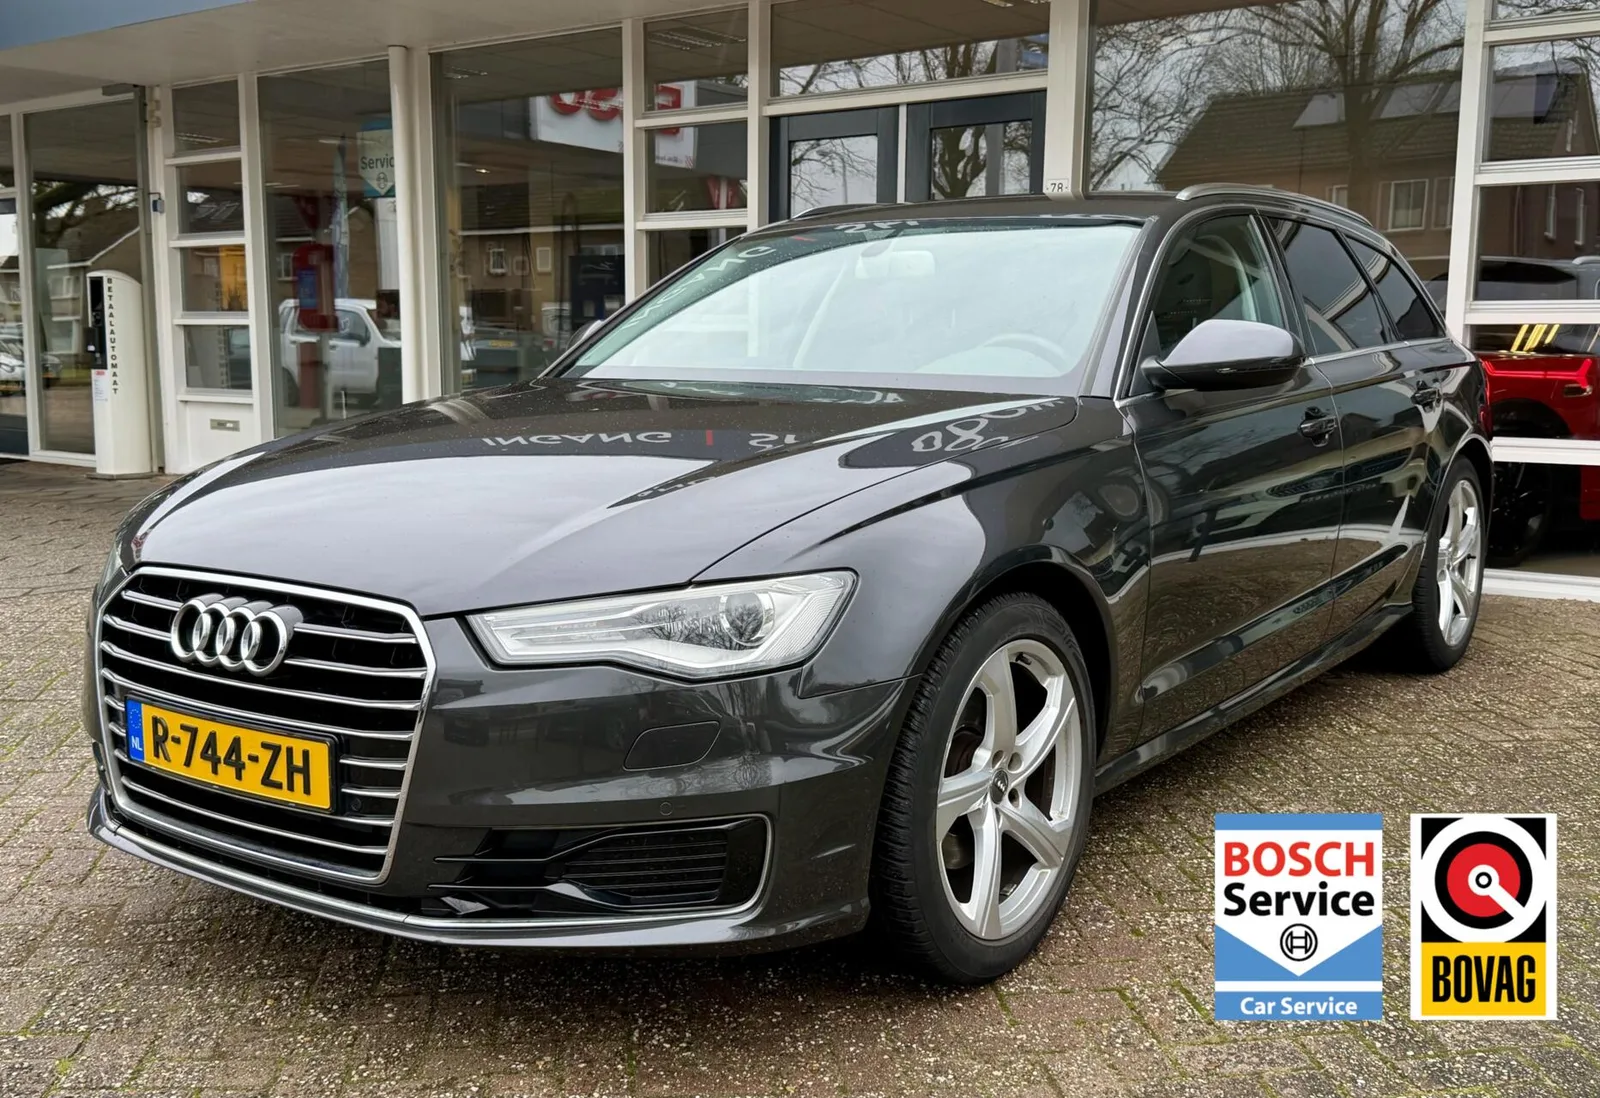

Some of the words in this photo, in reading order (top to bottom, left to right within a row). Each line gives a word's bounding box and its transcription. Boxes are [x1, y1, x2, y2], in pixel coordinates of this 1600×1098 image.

[361, 153, 395, 170] Servic
[1050, 182, 1064, 193] 78
[107, 277, 119, 395] BETAALAUTOMAAT
[131, 735, 143, 751] NL
[151, 714, 312, 796] R-744-ZH
